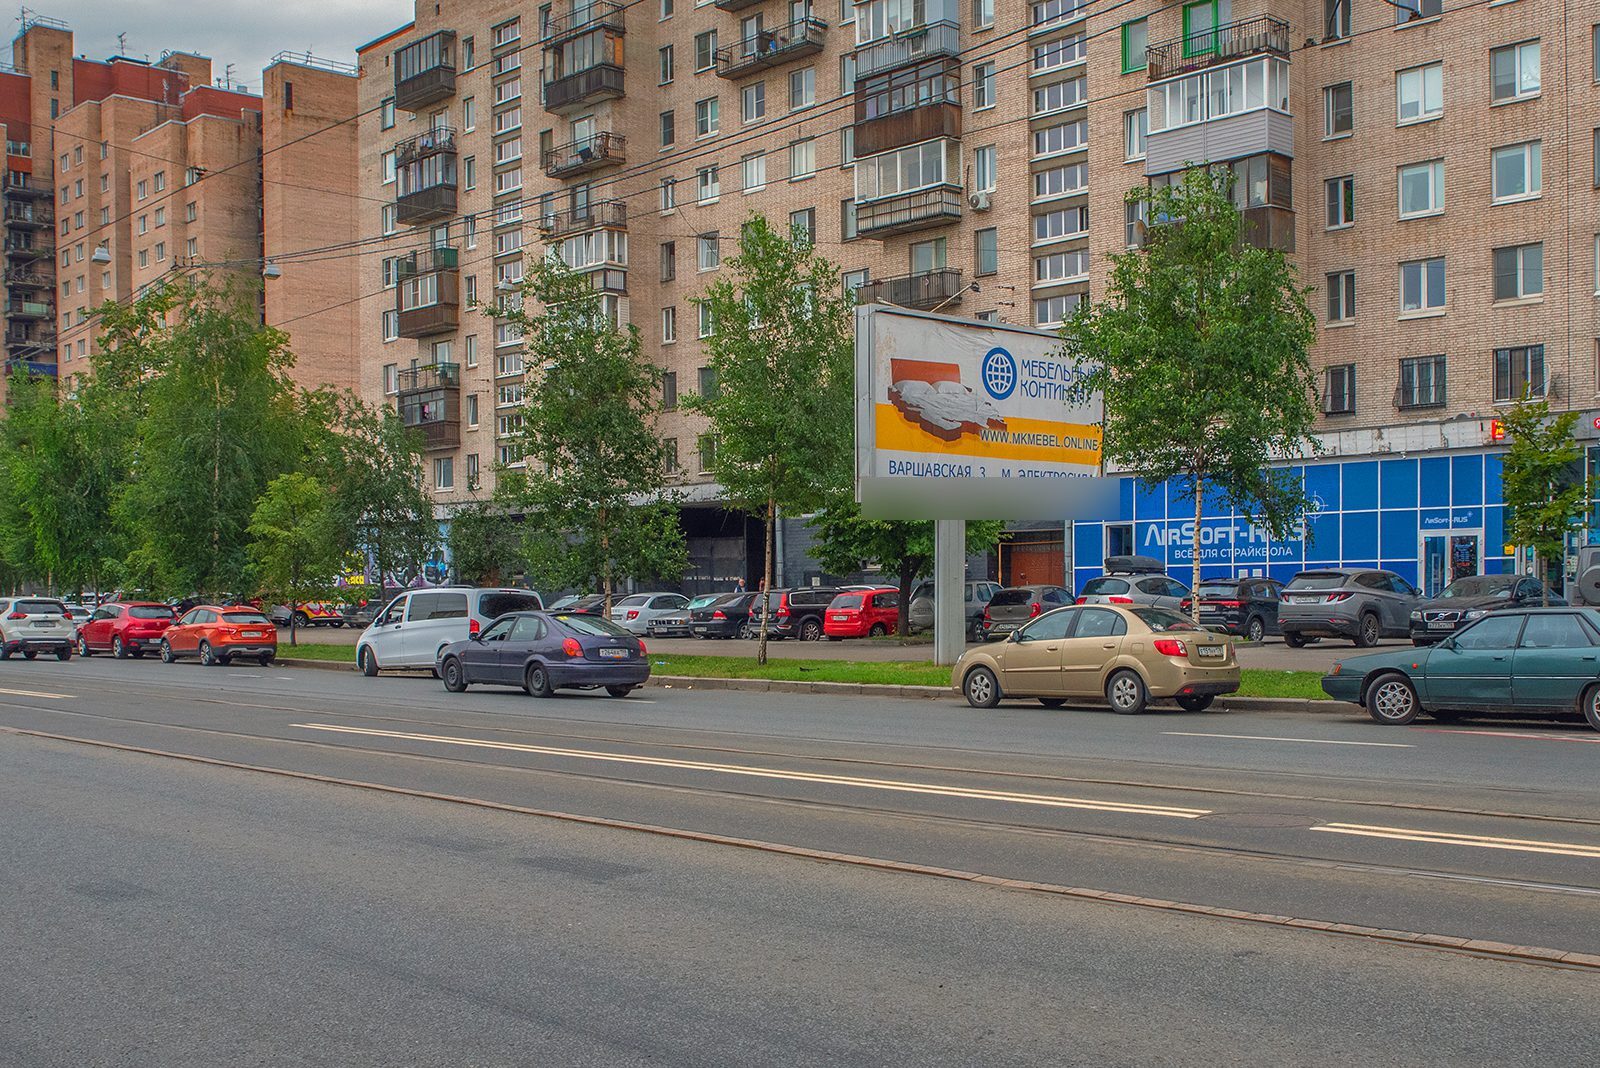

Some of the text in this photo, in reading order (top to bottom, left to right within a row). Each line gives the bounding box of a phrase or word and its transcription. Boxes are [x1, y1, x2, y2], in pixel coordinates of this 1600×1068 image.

[980, 430, 1098, 450] WWW.MKMEBEL.ONLINE
[889, 460, 971, 477] ВАРШАВСКАЯ
[1199, 548, 1217, 559] ДЛЯ
[1220, 546, 1293, 558] СТРАЙКБОЛА
